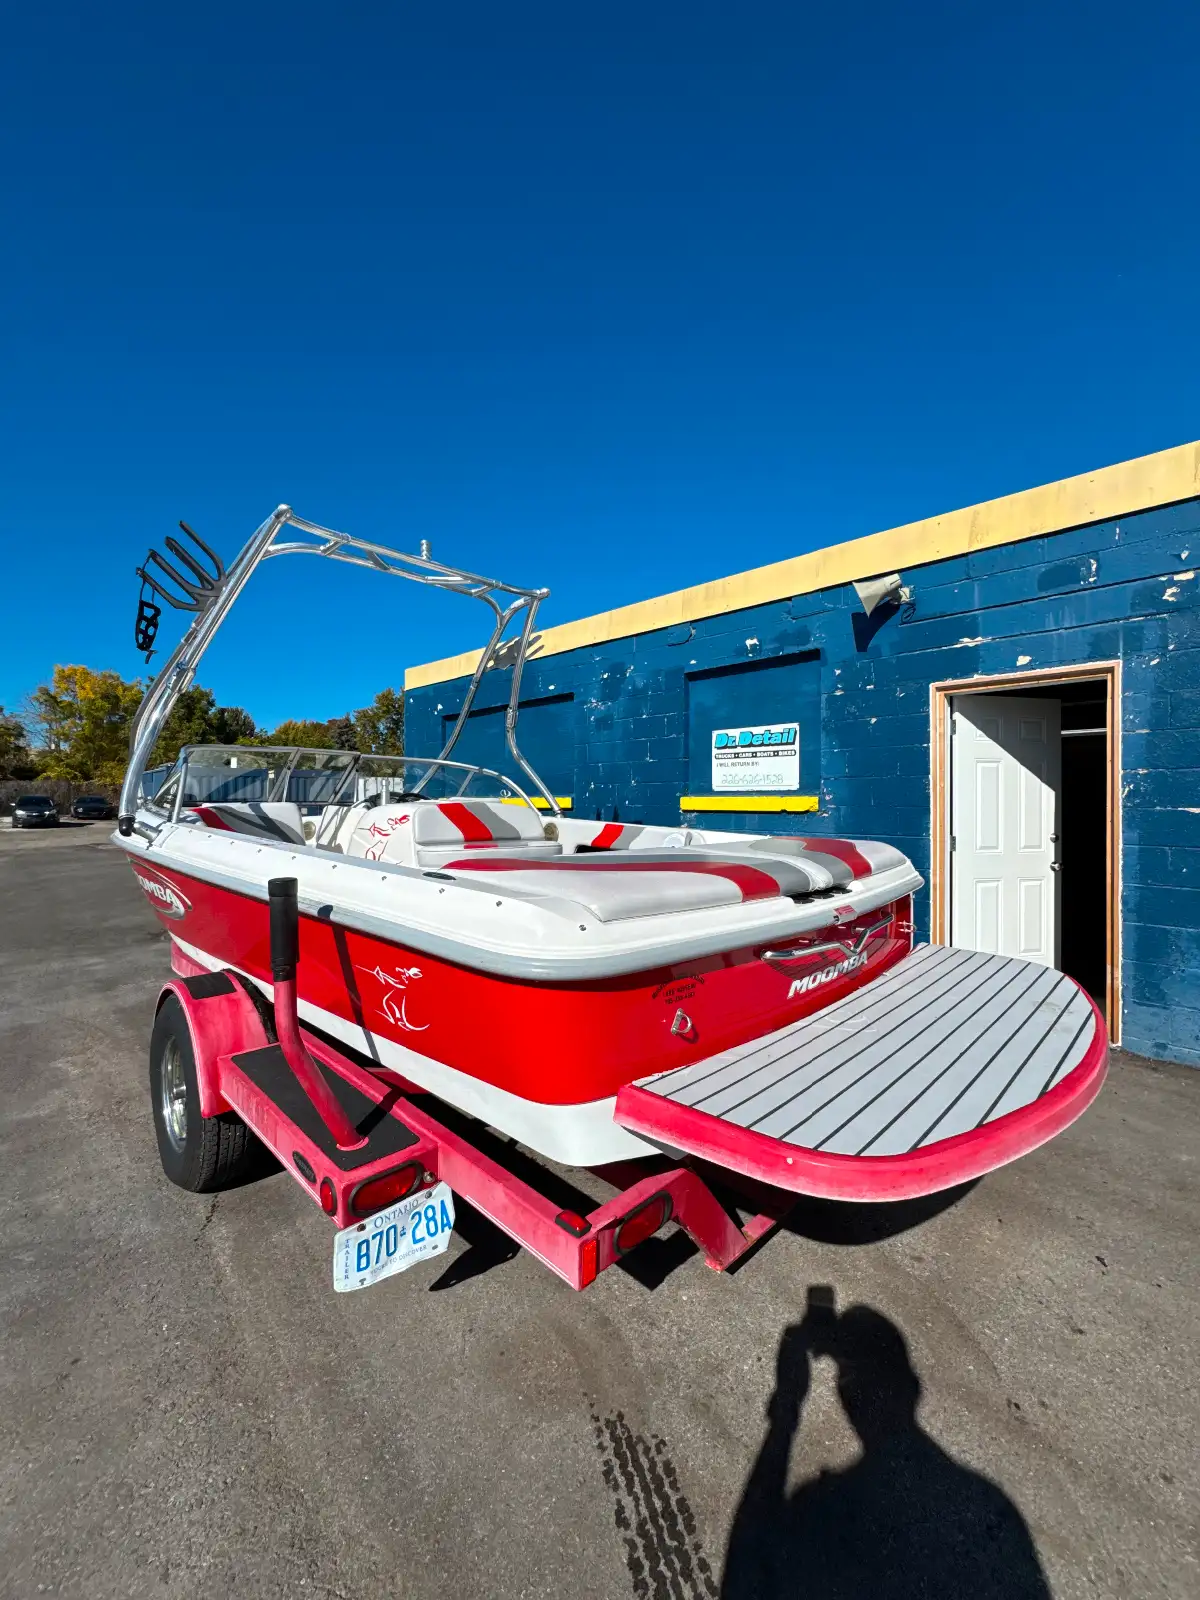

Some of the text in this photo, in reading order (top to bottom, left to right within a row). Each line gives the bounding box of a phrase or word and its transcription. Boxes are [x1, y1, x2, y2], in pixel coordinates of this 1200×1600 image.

[738, 728, 797, 748] Detail
[787, 951, 868, 999] MOOMBA
[374, 1199, 419, 1229] ONTARIO
[410, 1199, 453, 1246] 28A
[398, 1245, 428, 1262] DISCOVER
